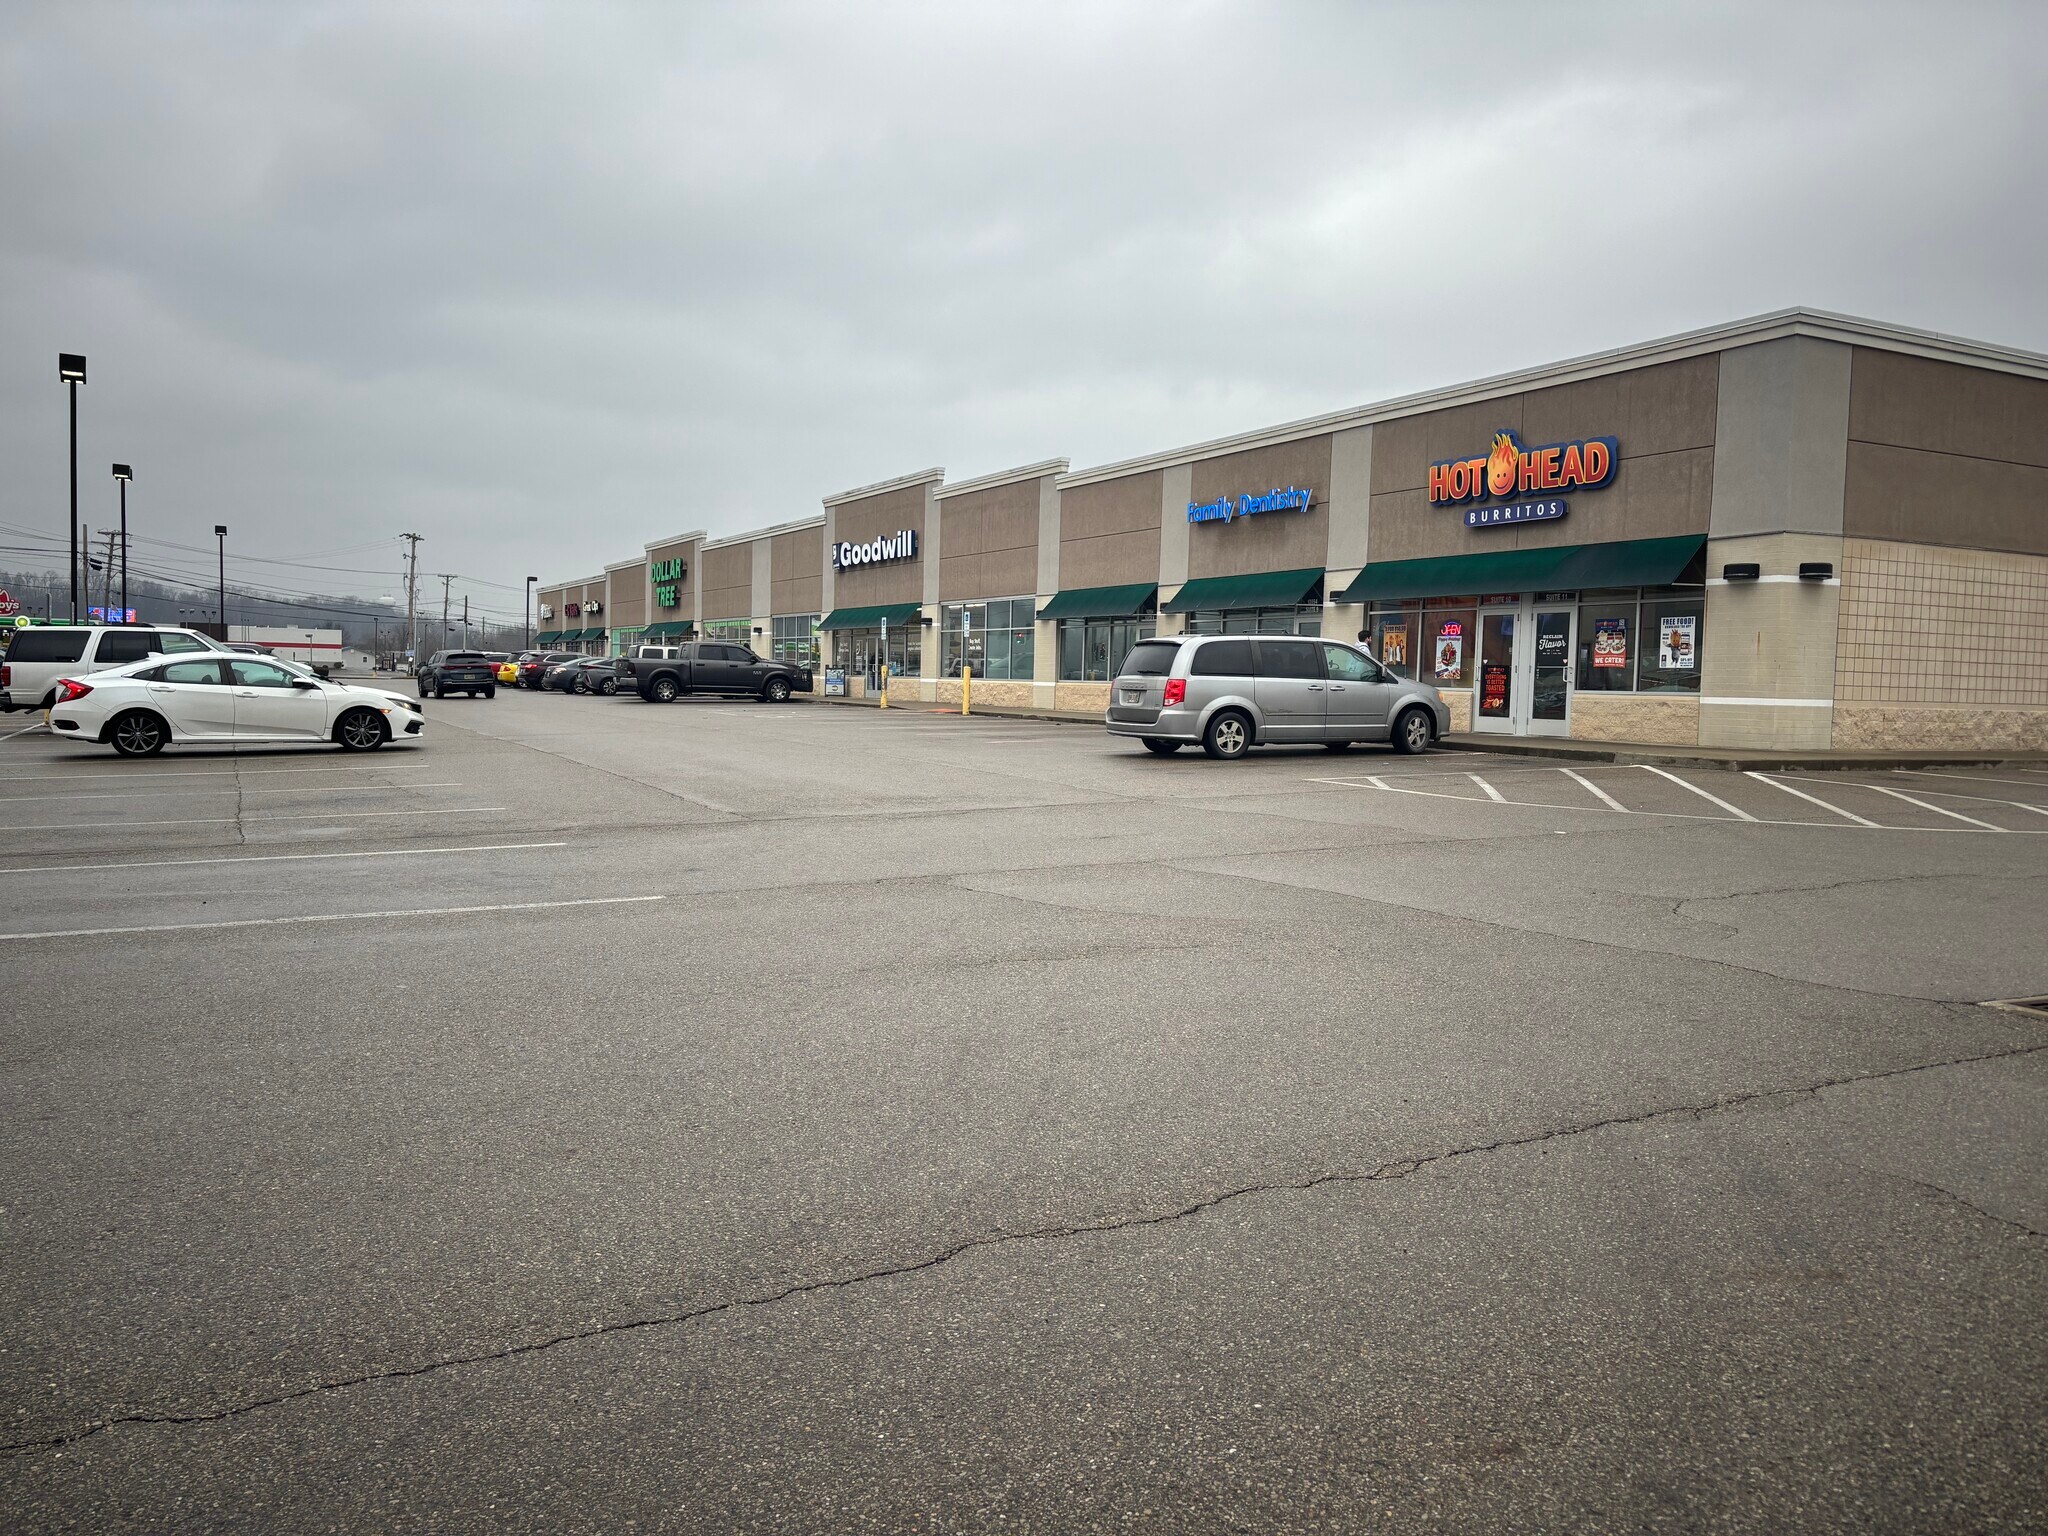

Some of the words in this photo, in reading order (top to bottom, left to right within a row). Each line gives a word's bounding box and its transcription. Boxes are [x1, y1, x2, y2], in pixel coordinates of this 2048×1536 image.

[1429, 458, 1487, 502] HOT
[1518, 441, 1609, 491] HEAD
[1187, 495, 1235, 523] Family
[1239, 486, 1312, 513] Dentistry
[1469, 502, 1557, 523] BURRITOS
[840, 530, 912, 567] Goodwill
[651, 558, 683, 584] DOLLAR
[656, 585, 677, 607] TREE
[1546, 593, 1560, 601] SUITE
[1677, 617, 1694, 625] FOOD!
[1538, 639, 1567, 650] Flavor
